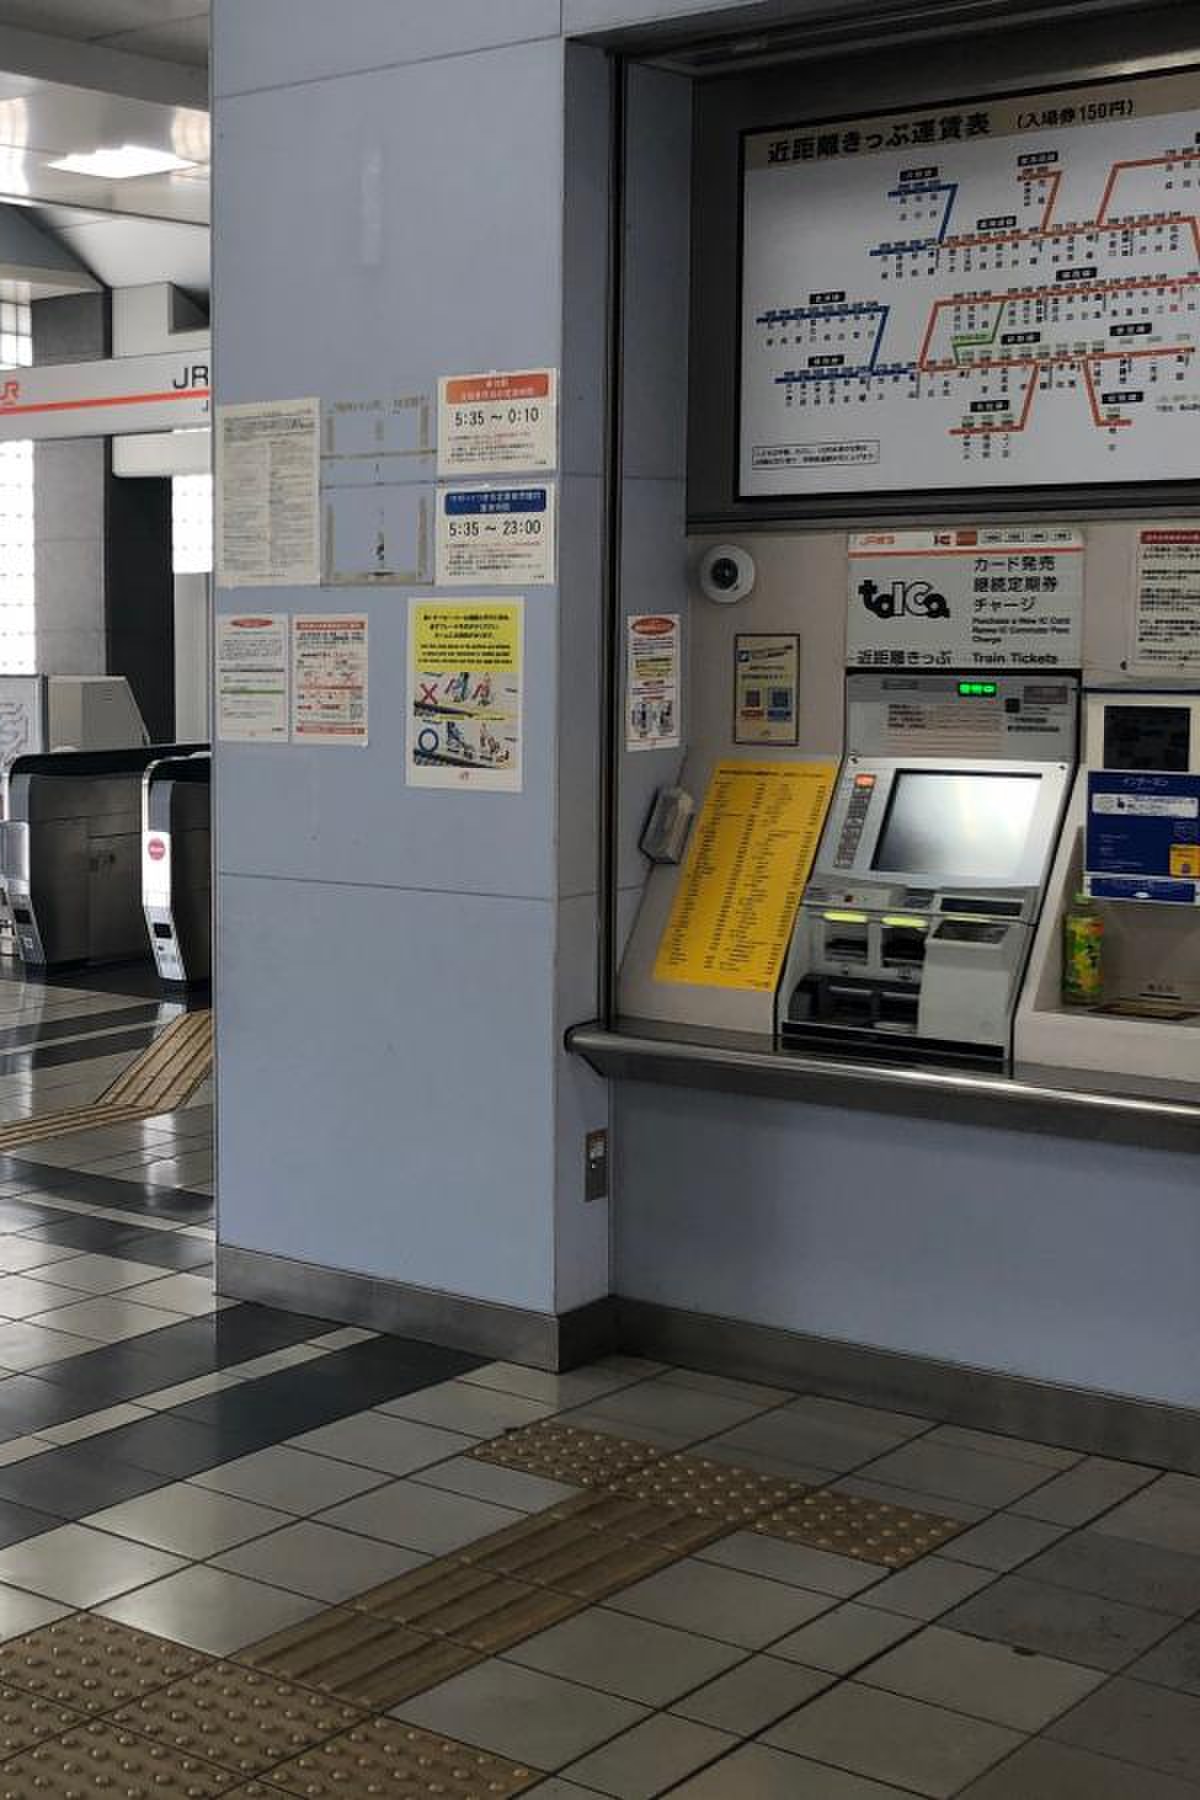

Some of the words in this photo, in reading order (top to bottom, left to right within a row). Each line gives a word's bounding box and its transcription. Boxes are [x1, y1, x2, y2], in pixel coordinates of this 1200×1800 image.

[767, 112, 991, 163] 近距離きっぷ運賃表
[455, 408, 485, 427] 5:35
[507, 407, 539, 424] 0:10
[449, 521, 480, 537] 5:35
[502, 519, 541, 536] 23:00
[974, 556, 1056, 573] カード発売
[973, 575, 1058, 593] 継続定期券
[973, 596, 1036, 613] チャージ
[856, 650, 952, 666] 近距離きっぷ
[972, 652, 1006, 665] Train
[1010, 652, 1059, 665] Tickets
